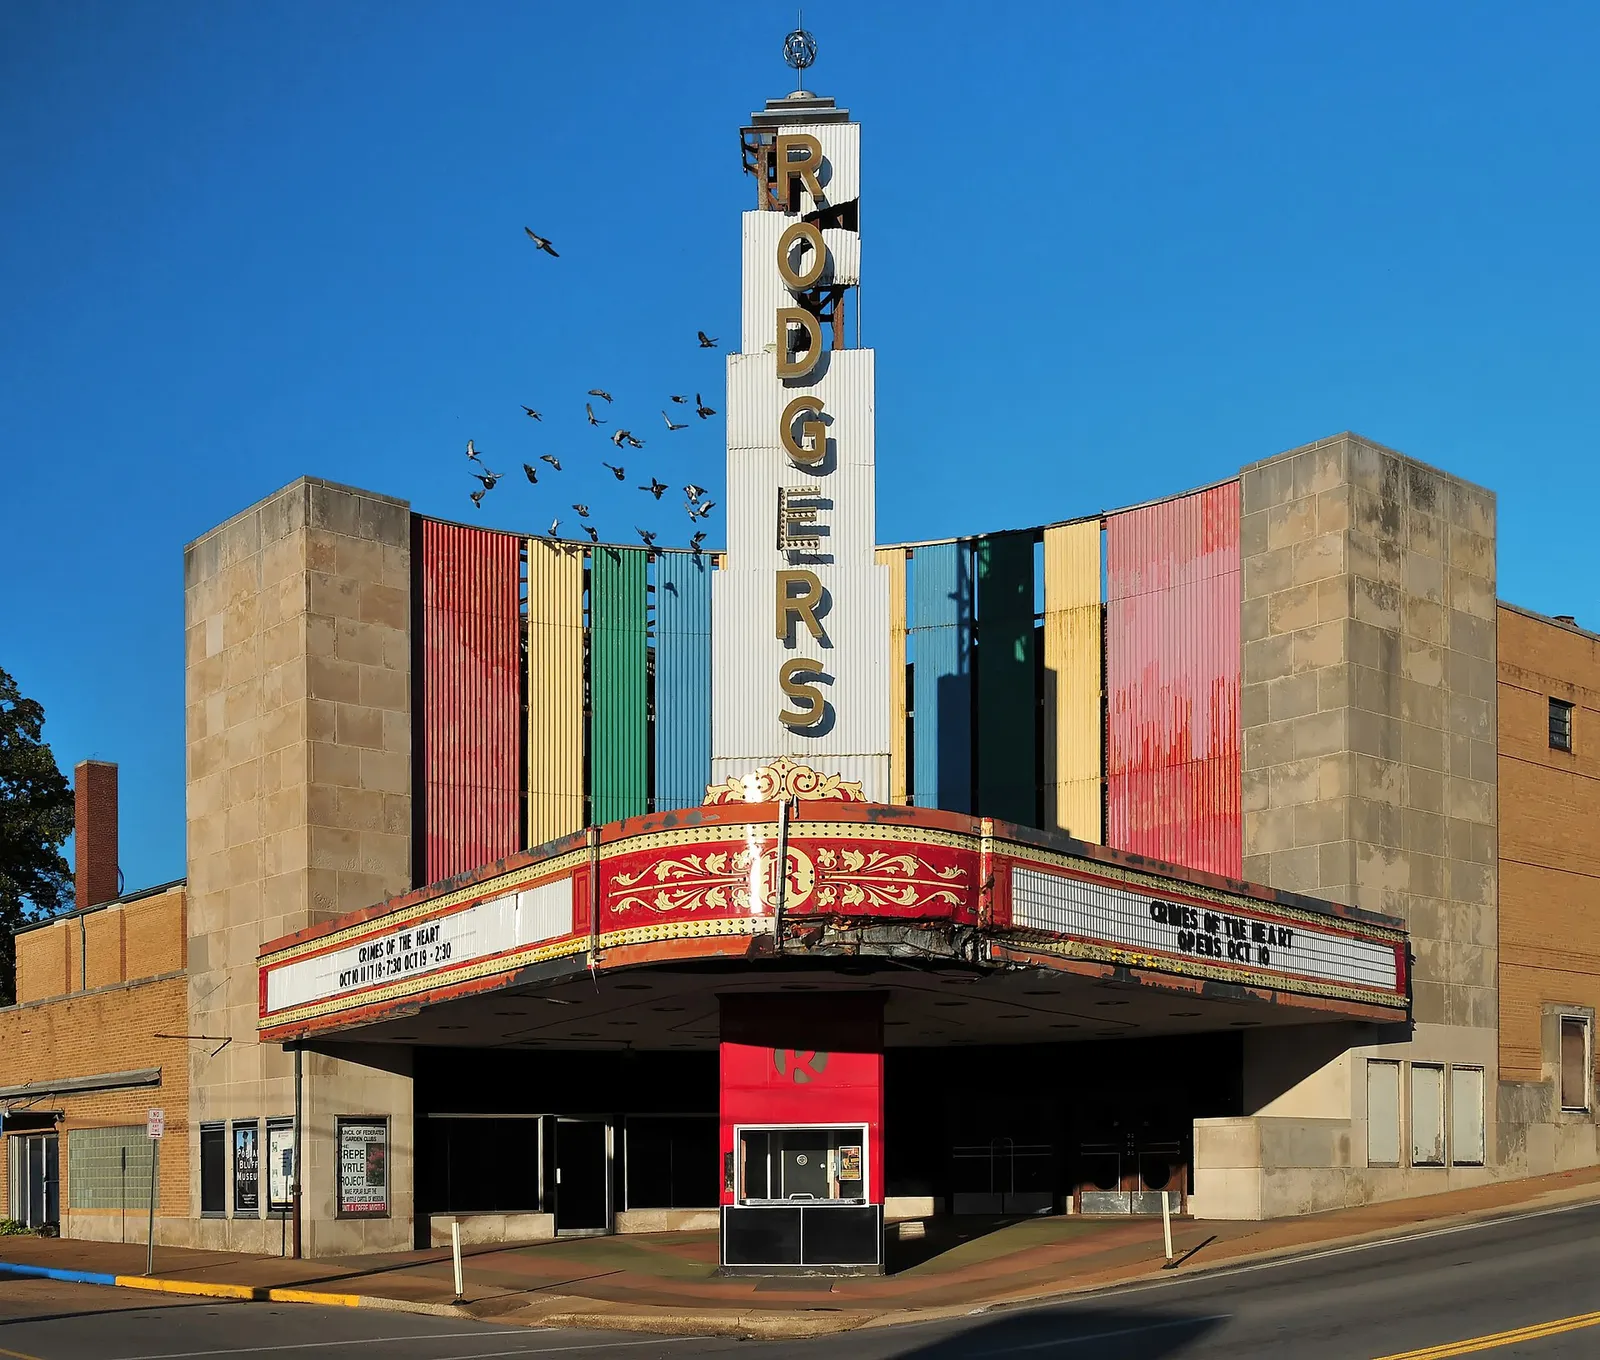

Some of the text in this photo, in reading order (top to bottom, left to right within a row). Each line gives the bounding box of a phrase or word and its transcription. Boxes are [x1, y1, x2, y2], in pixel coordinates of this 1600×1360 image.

[776, 133, 827, 727] RODGERS
[1150, 900, 1294, 949] CRIMES OF THE HEART
[358, 925, 440, 963] CRIMES OF THE HEART
[1177, 930, 1270, 966] OPENS OCT 10
[339, 971, 351, 987] OCT
[352, 969, 358, 985] 10
[404, 953, 418, 970] OCT
[419, 950, 427, 967] 19
[435, 942, 451, 962] 2:30
[239, 1160, 259, 1169] BLUFF
[341, 1149, 365, 1159] REPE
[237, 1171, 258, 1181] MUSEU
[342, 1163, 364, 1173] YRTLE
[341, 1176, 364, 1186] ROJECT
